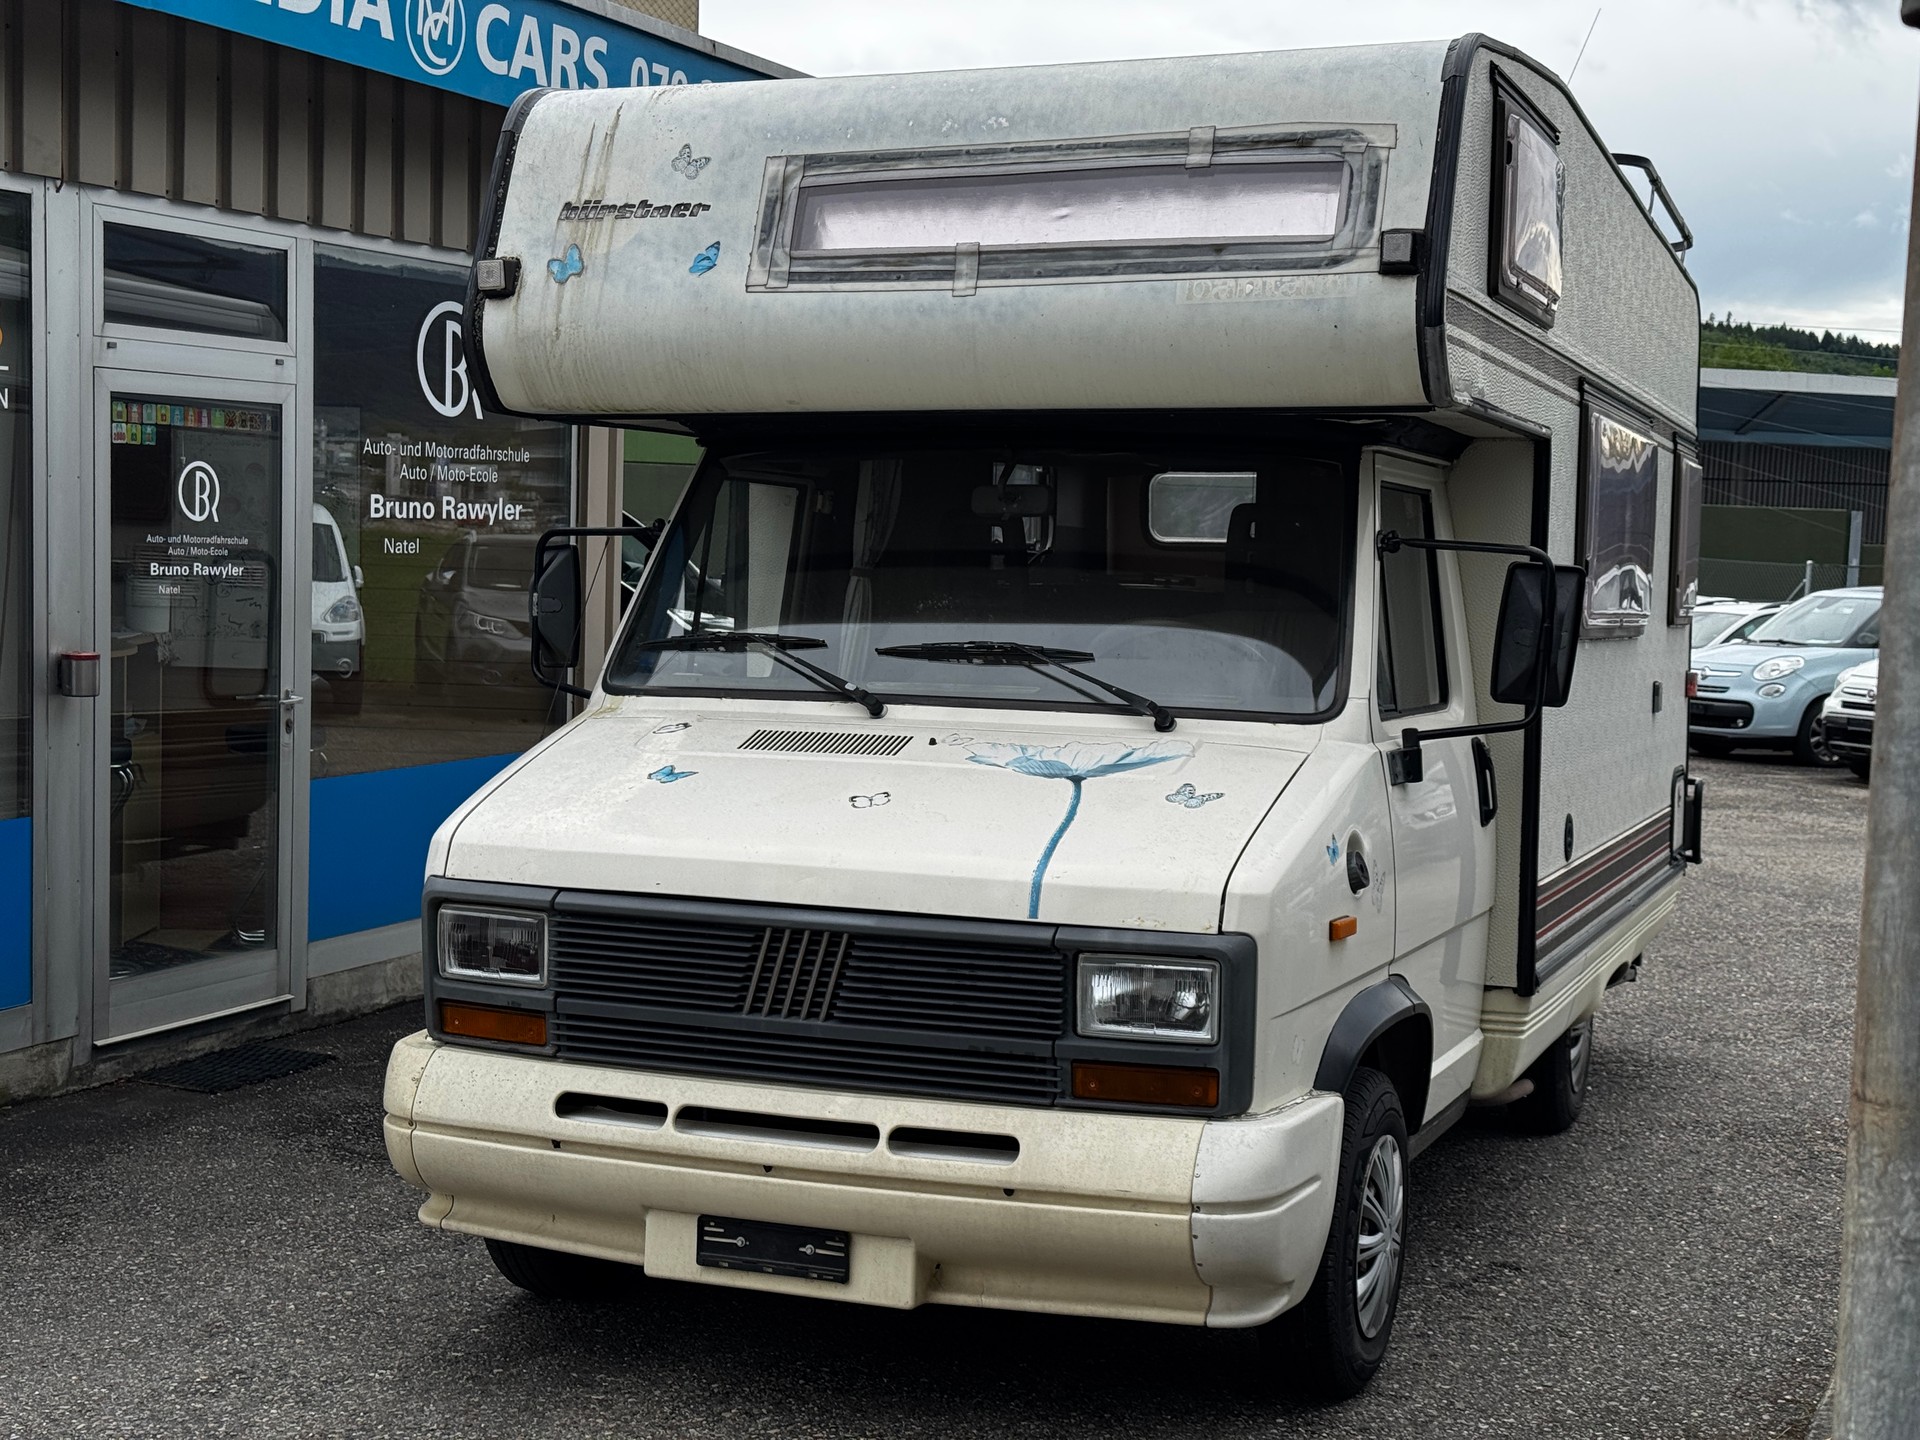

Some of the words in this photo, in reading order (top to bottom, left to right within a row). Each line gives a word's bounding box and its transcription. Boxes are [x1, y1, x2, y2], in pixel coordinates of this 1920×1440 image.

[476, 3, 608, 89] CARS
[363, 438, 396, 456] Auto-
[400, 441, 422, 457] und
[425, 441, 530, 463] Motorradfahrschule
[400, 464, 428, 481] Auto
[437, 465, 498, 483] Moto-Ecole
[370, 493, 436, 520] Bruno
[442, 495, 523, 526] Rawyler
[146, 534, 166, 544] Auto-
[167, 535, 182, 544] und
[183, 534, 249, 545] Motorradfahrschule
[384, 538, 420, 554] Natel
[167, 547, 184, 556] Auto
[190, 547, 229, 556] Moto-Ecole
[150, 562, 190, 576] Bruno
[193, 562, 245, 579] Rawyler
[158, 585, 181, 594] Natel
